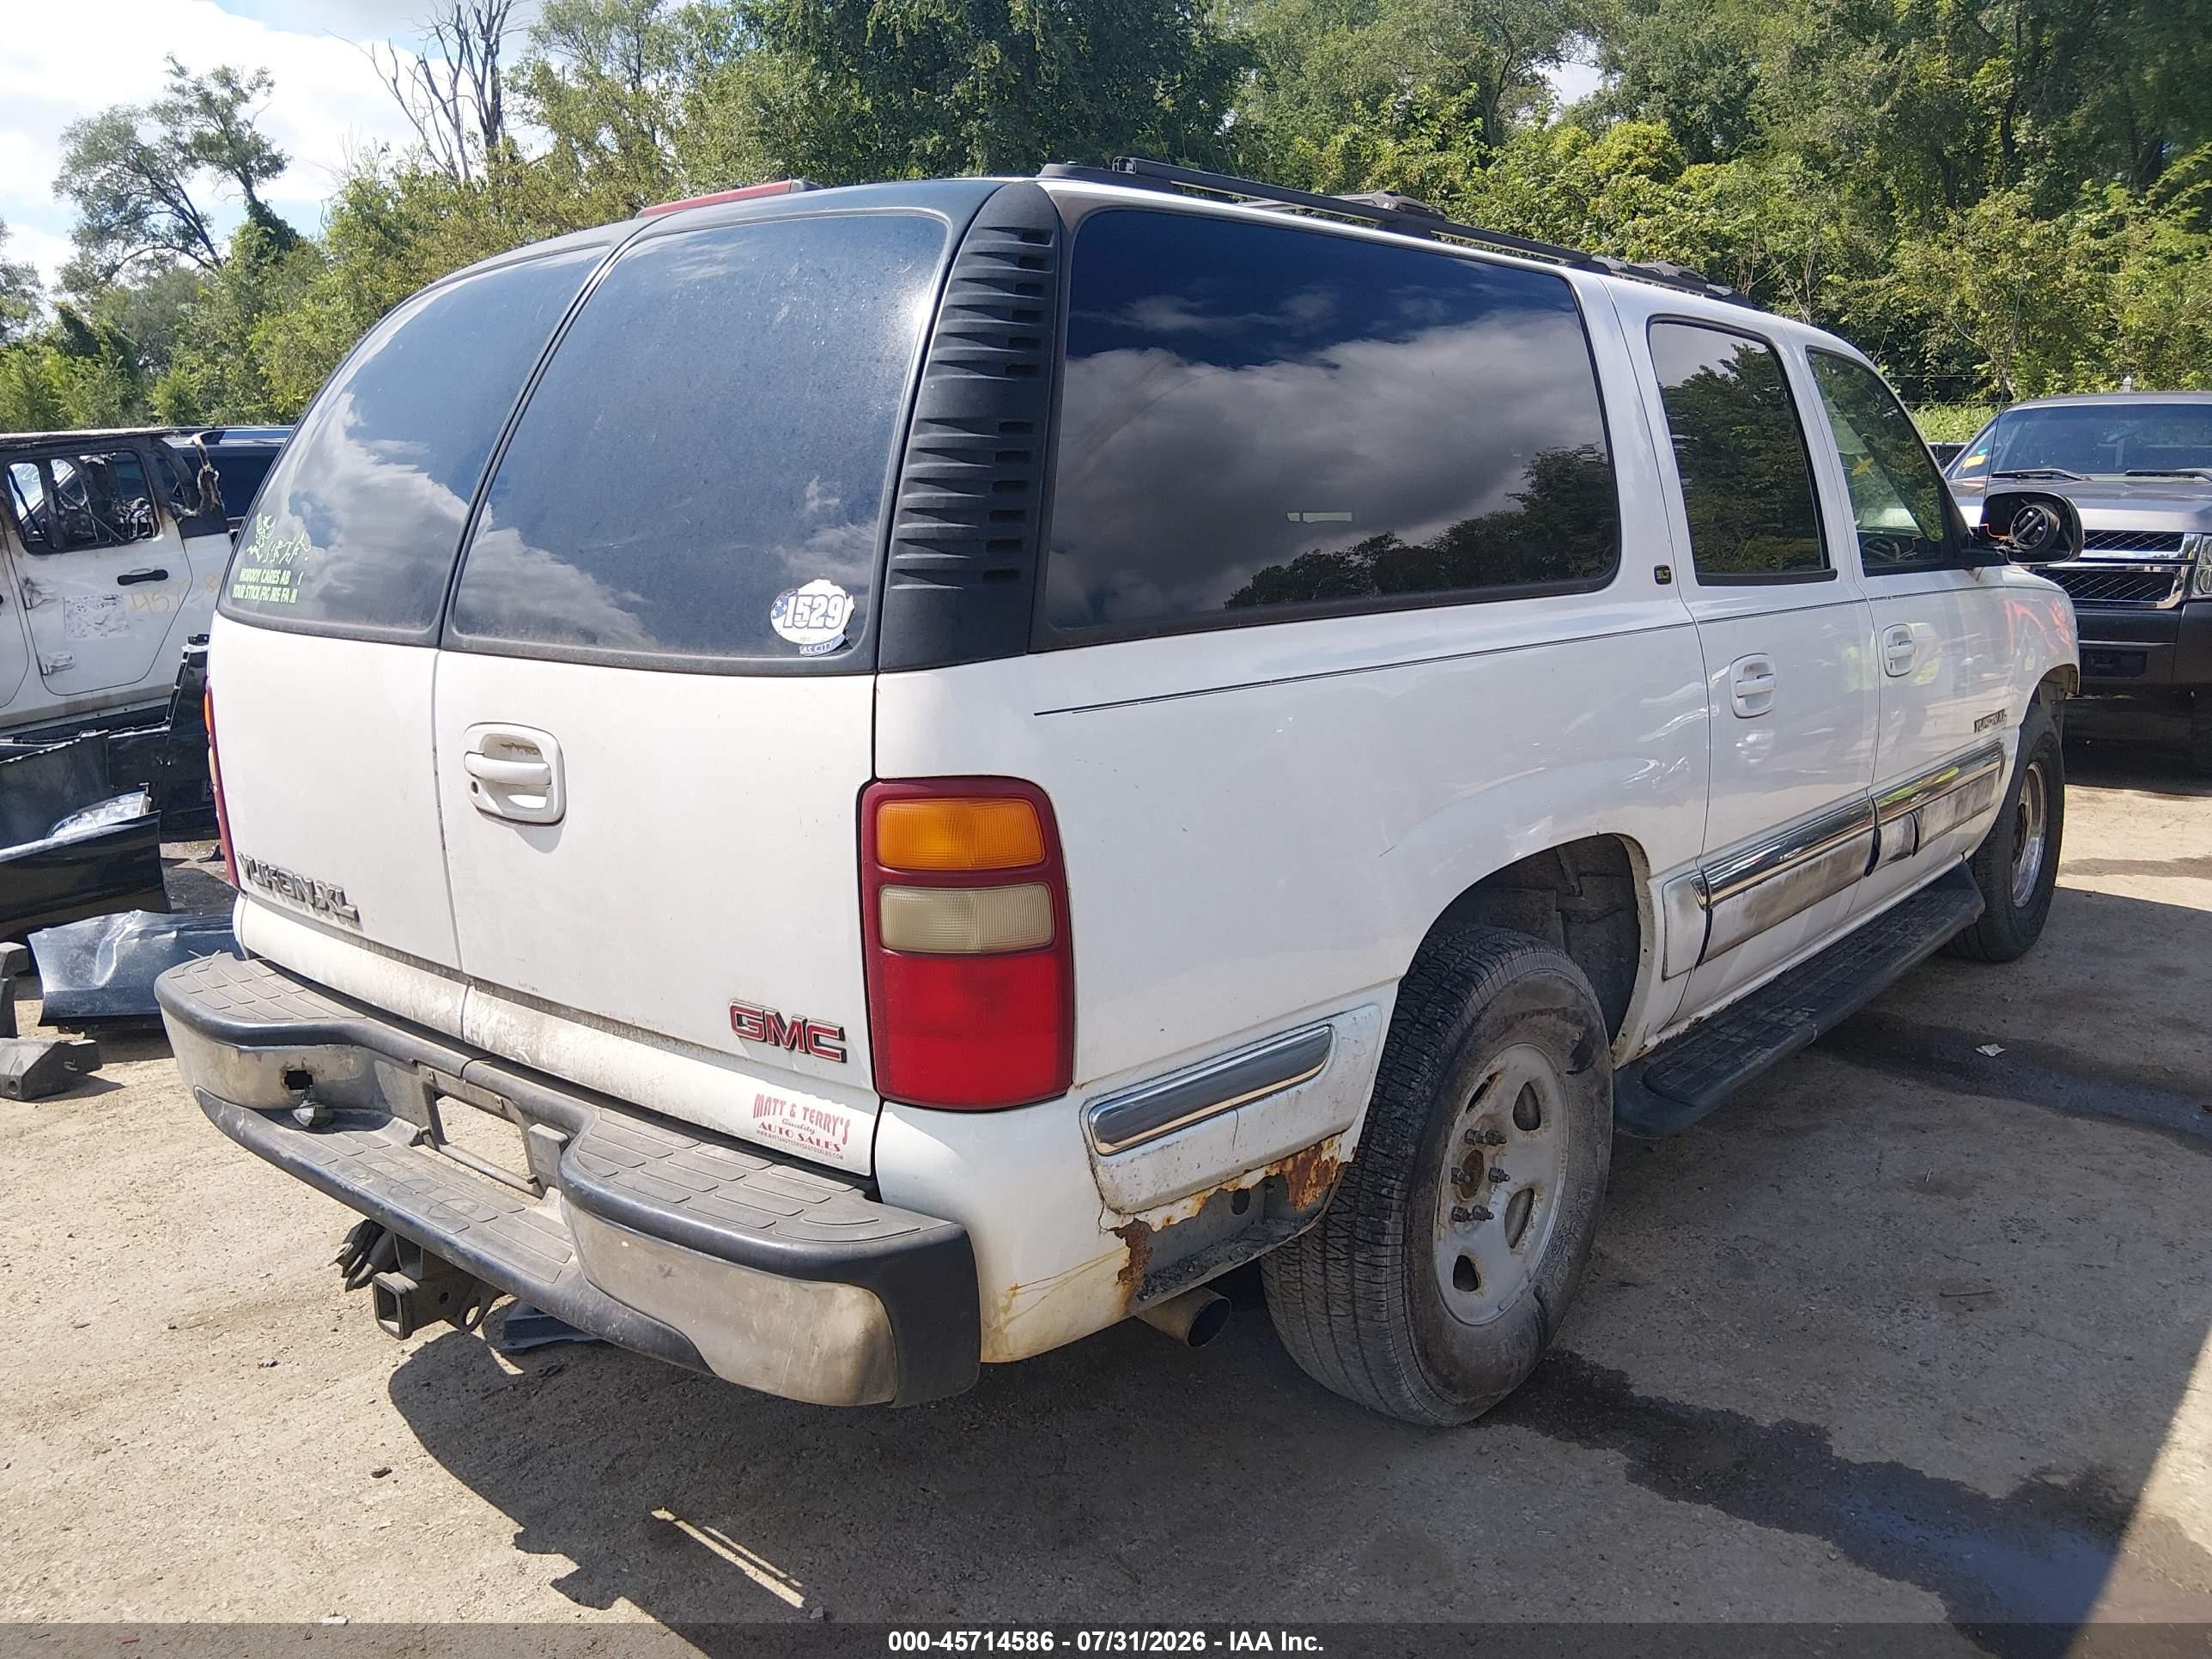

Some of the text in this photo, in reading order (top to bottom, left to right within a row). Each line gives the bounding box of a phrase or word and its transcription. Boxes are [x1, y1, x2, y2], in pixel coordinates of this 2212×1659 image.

[232, 584, 246, 599] YOUR
[244, 585, 262, 600] STICK
[239, 568, 262, 584] NOBODY
[260, 568, 282, 585] CARES
[783, 593, 846, 629] 1529
[814, 640, 834, 653] CITY
[236, 851, 315, 904] YUKON
[728, 999, 848, 1063] GMC
[752, 1093, 851, 1146] MATT & TERRY'S
[781, 1118, 817, 1135] Quality
[757, 1121, 842, 1152] AUTO SALES
